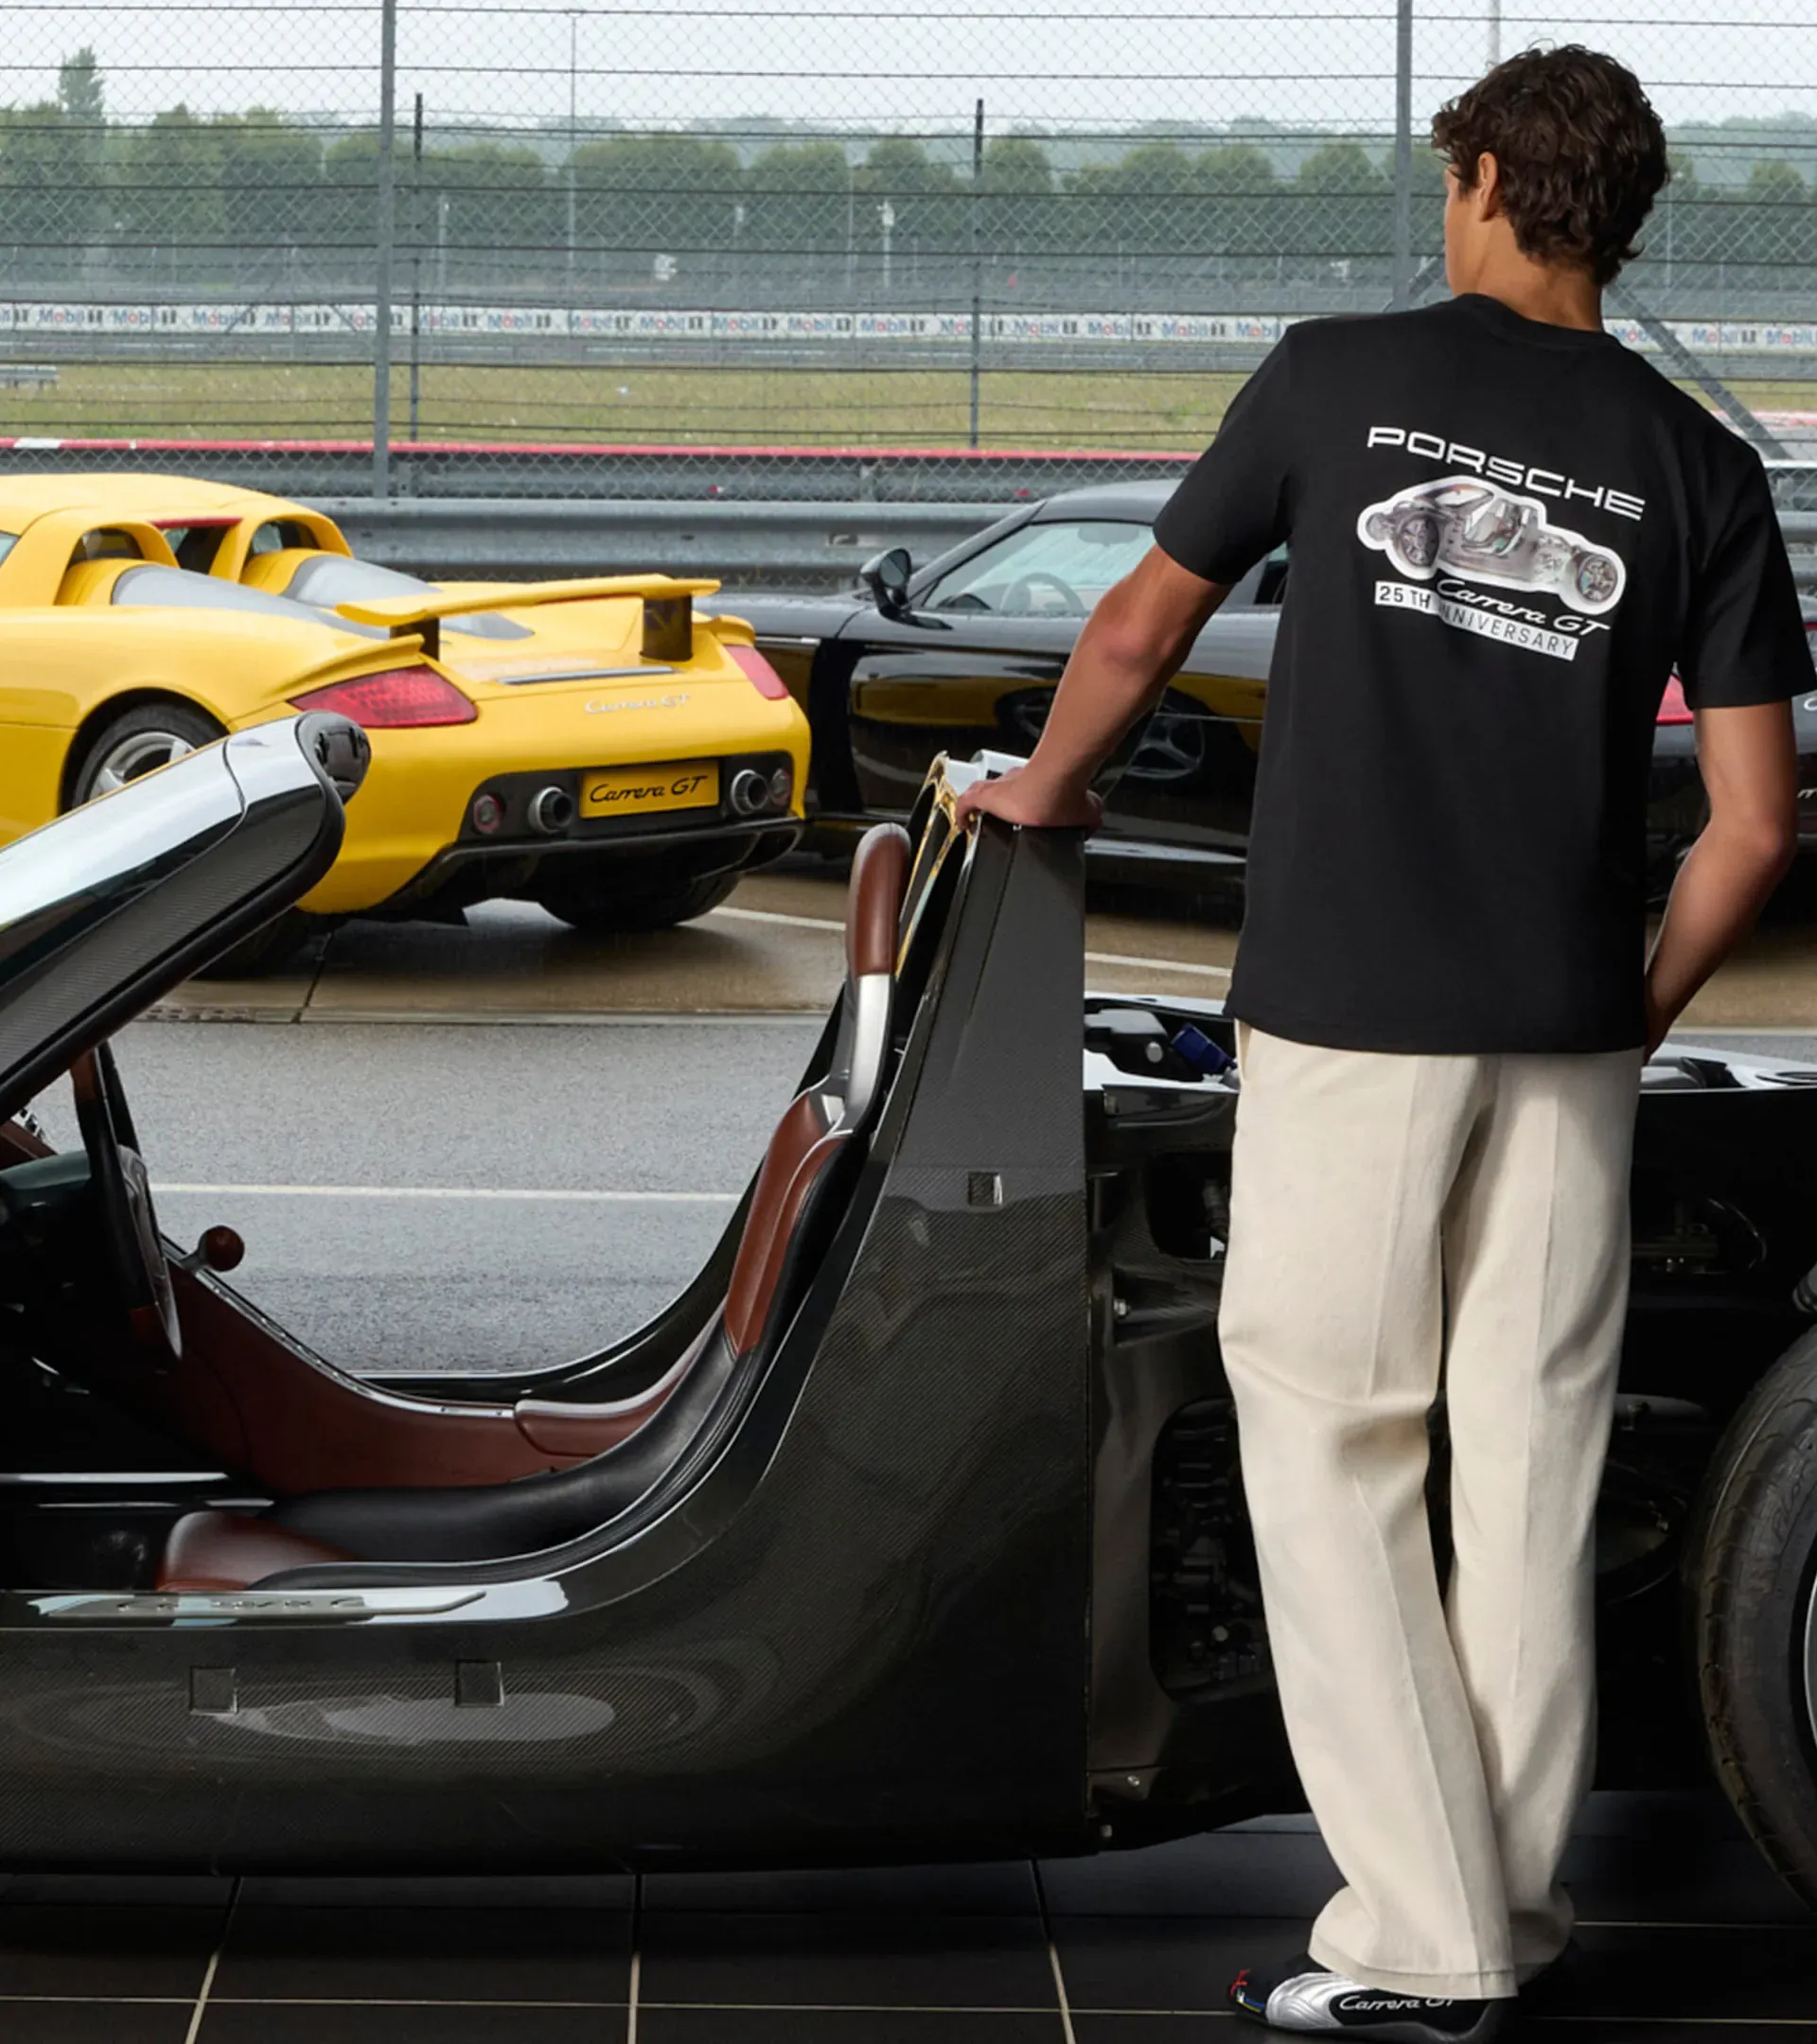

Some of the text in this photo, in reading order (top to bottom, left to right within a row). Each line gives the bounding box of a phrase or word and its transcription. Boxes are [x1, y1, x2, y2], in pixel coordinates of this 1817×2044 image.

[1367, 427, 1646, 520] PORSCHE
[1437, 579, 1611, 636] Carrera GT
[585, 694, 691, 714] Carrera GT
[590, 774, 709, 803] Carrera GT
[1339, 1995, 1420, 2011] Carrera
